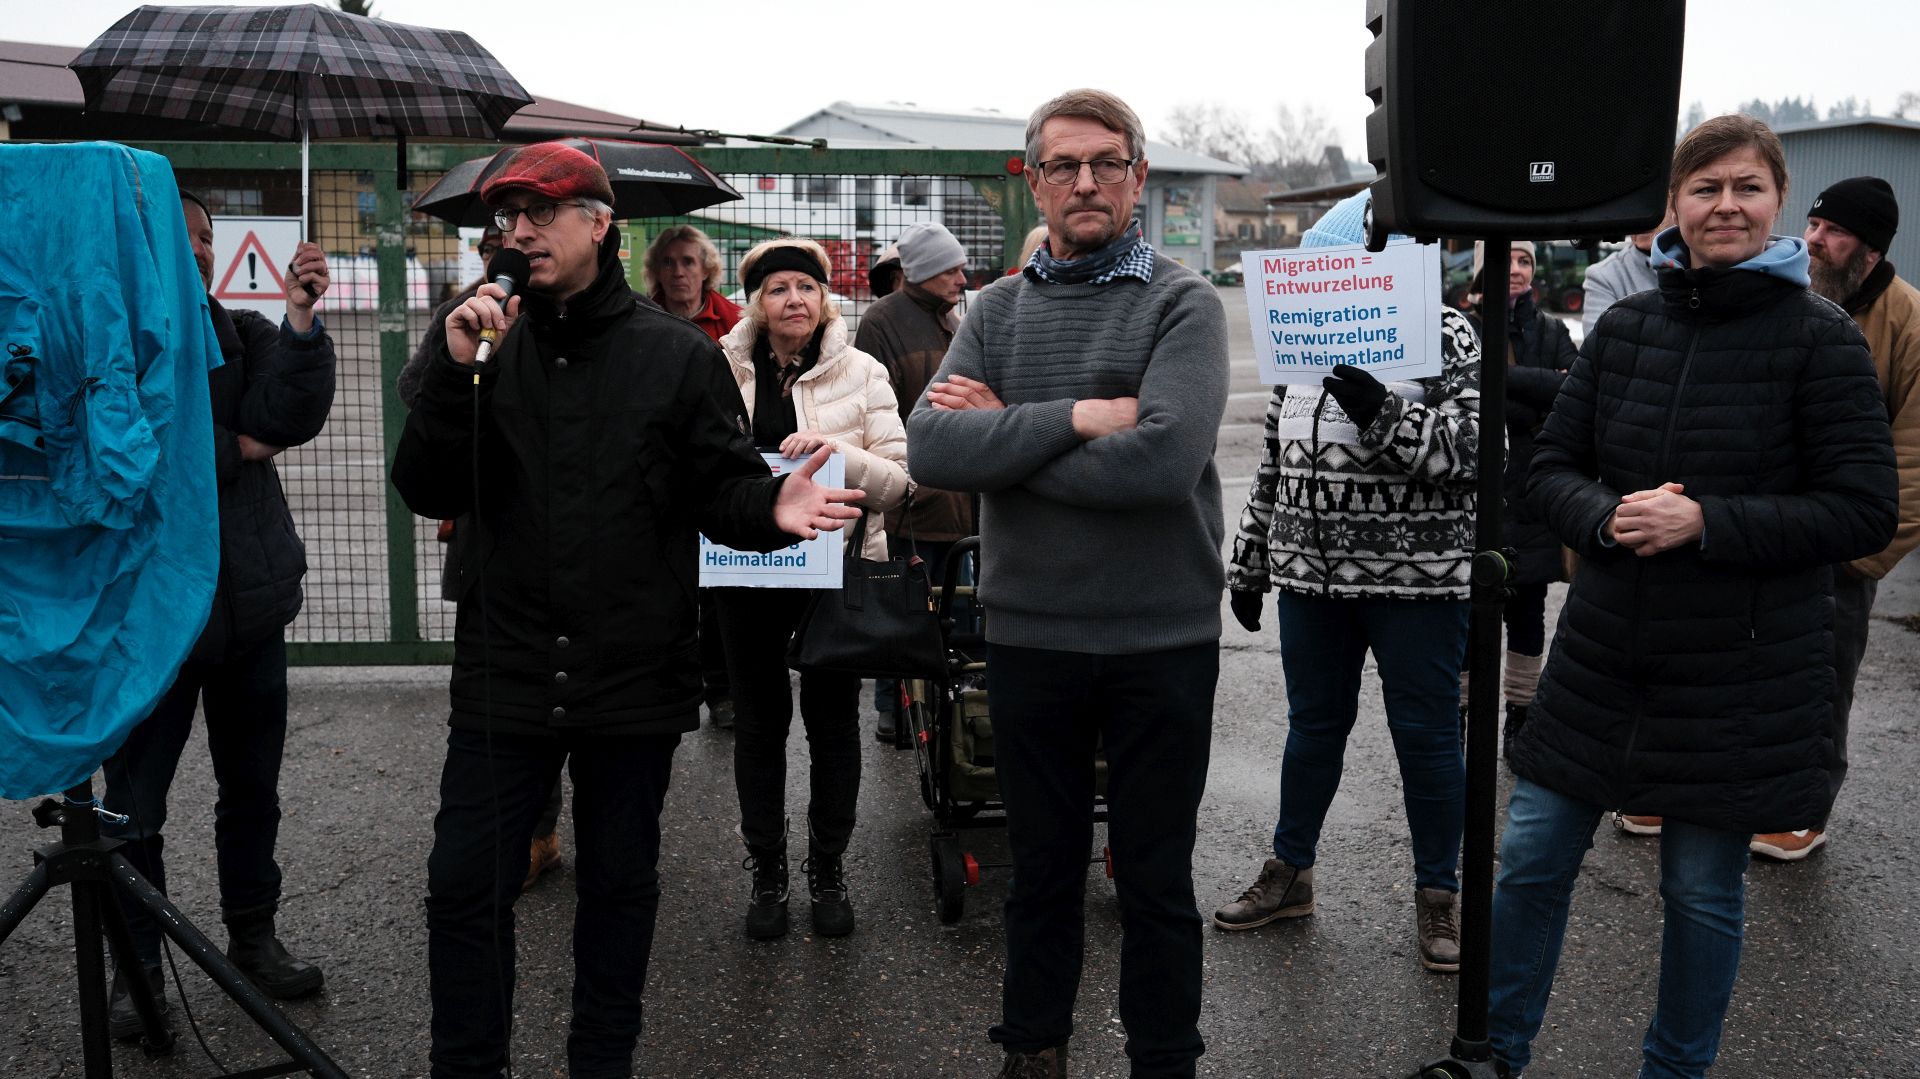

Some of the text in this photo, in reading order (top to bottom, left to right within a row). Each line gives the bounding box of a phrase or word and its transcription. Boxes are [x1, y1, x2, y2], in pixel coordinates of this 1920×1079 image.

[1532, 164, 1553, 176] LD
[1264, 255, 1373, 277] Migration =
[1266, 275, 1394, 295] Entwurzelung
[1269, 305, 1398, 327] Remigration =
[1271, 327, 1397, 345] Verwurzelung
[1275, 344, 1404, 366] im Heimatland
[705, 551, 806, 567] Heimatland
